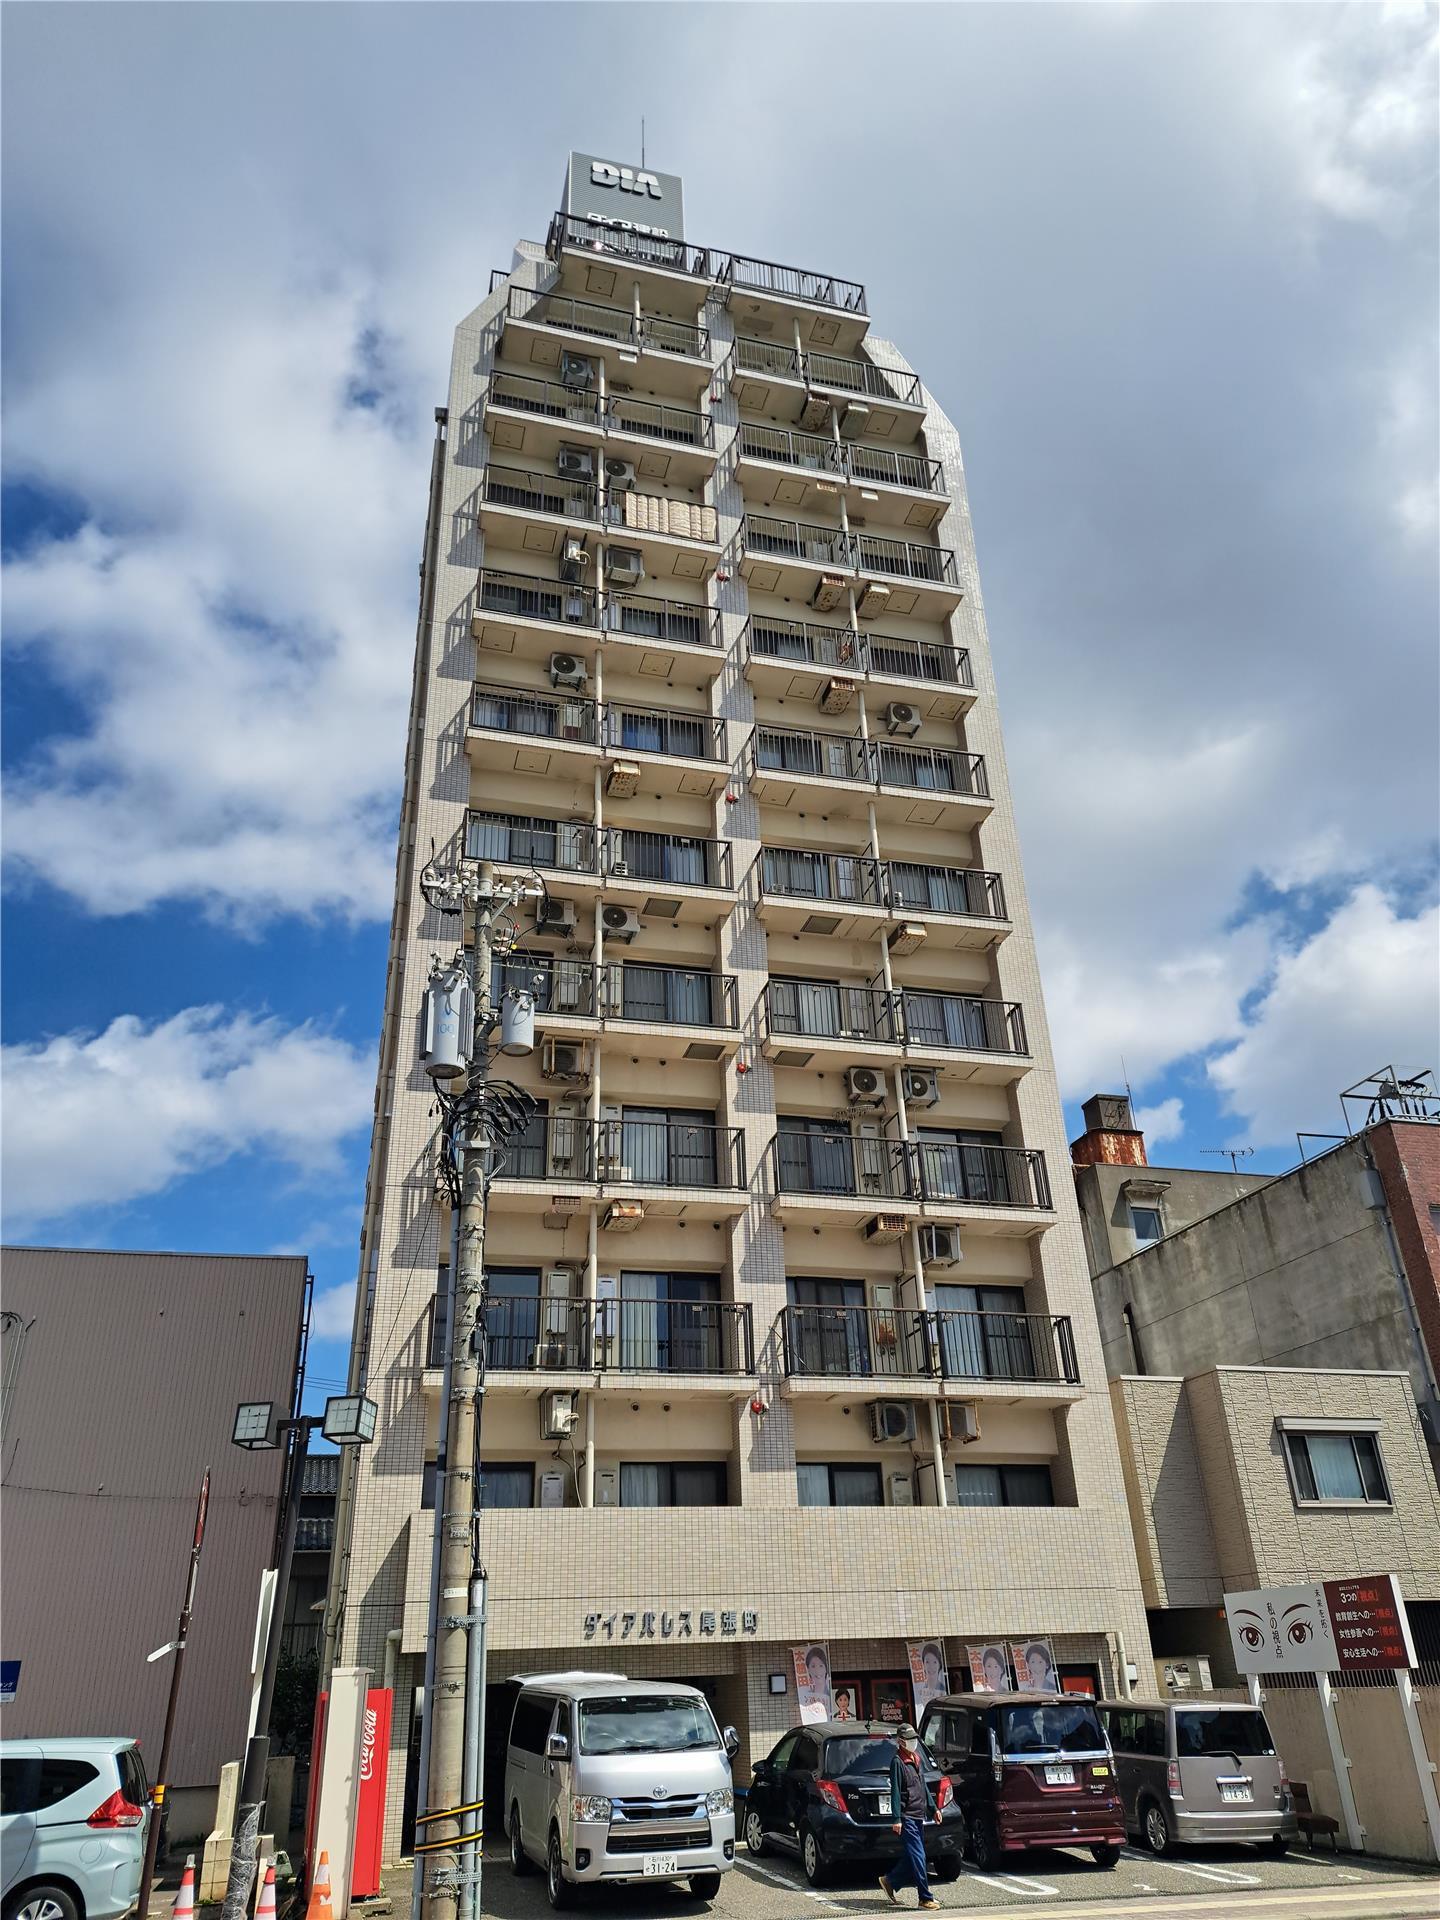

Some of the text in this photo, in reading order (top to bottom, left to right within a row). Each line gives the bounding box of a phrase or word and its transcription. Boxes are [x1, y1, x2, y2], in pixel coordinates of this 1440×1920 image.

[591, 161, 663, 200] DIA
[585, 1610, 759, 1640] ダイアパレス尾張町
[651, 1862, 676, 1874] 31-24
